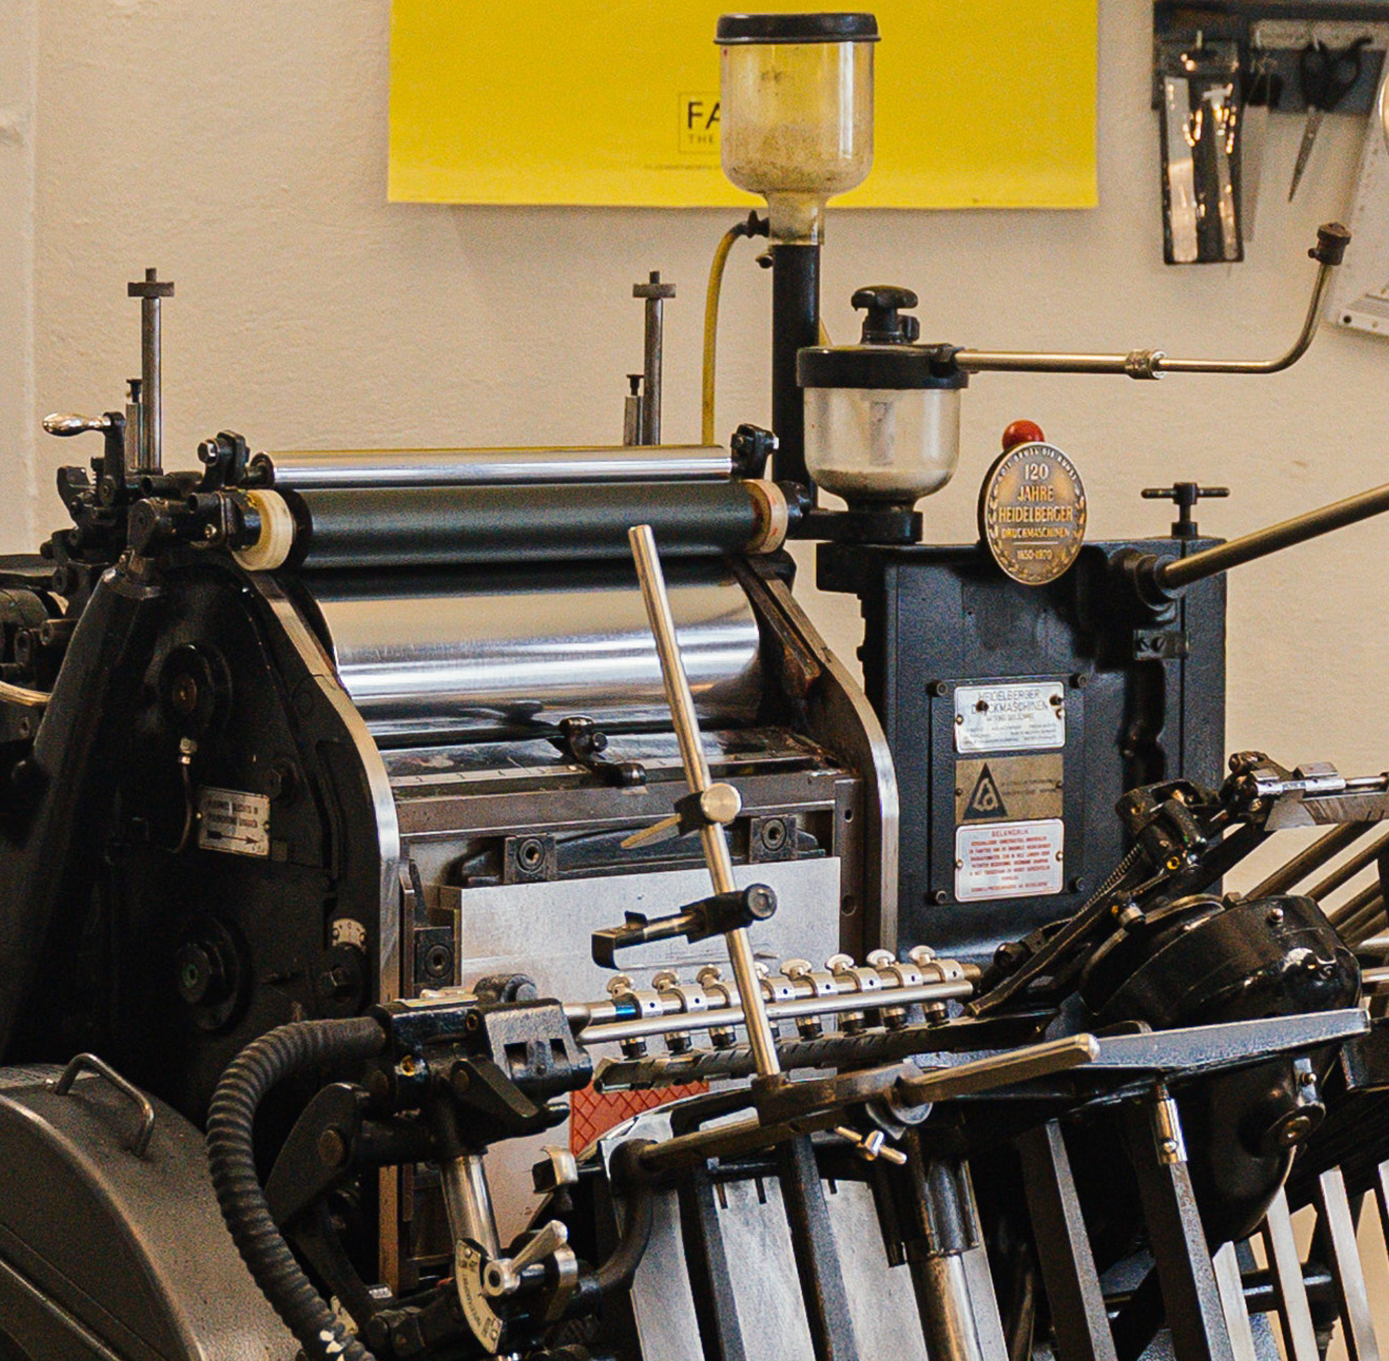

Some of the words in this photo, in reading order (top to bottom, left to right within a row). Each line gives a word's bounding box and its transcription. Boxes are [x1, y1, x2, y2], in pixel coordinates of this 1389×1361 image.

[1024, 462, 1049, 480] 120
[1017, 485, 1054, 502] JAHRE
[998, 506, 1073, 523] HEIDELBERGER
